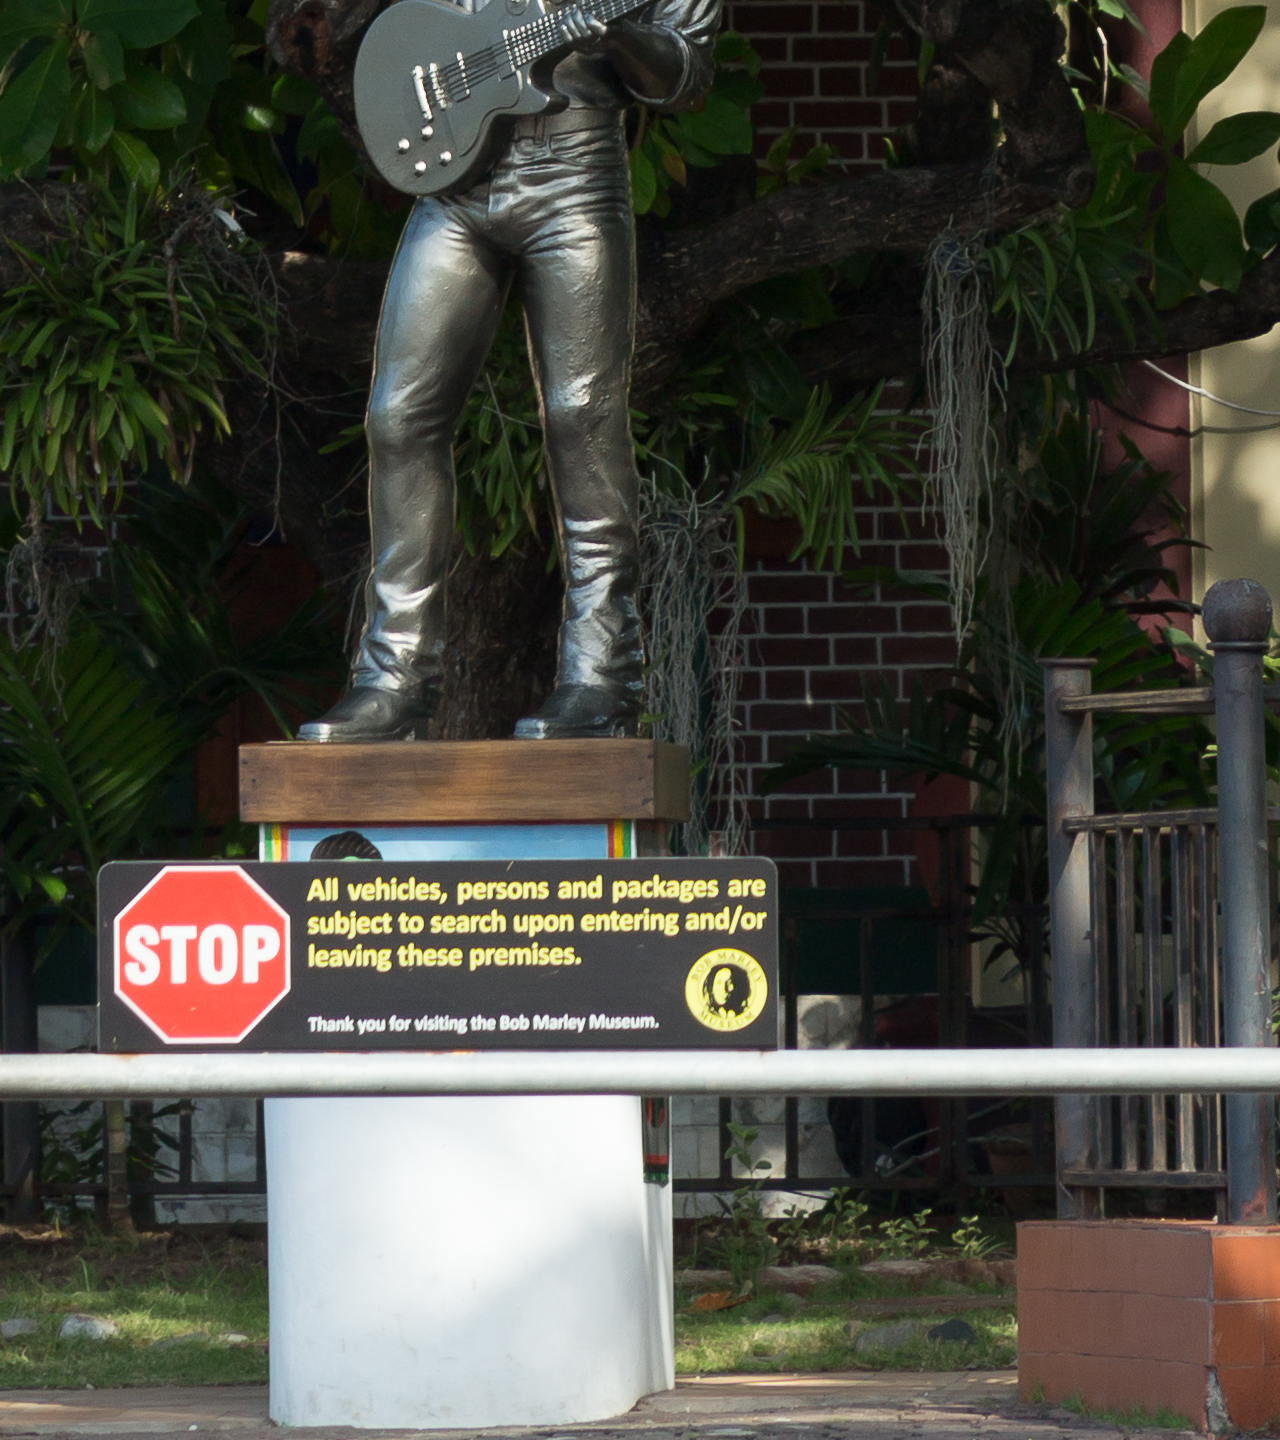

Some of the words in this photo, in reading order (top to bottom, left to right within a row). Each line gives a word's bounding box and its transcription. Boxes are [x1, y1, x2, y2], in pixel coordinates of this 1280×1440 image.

[306, 877, 339, 902] All
[347, 876, 448, 905] vehicles,
[457, 881, 550, 905] persons
[557, 874, 603, 899] and
[612, 874, 719, 904] packages
[727, 878, 766, 898] are
[307, 910, 393, 939] subject
[397, 912, 424, 934] to
[430, 908, 506, 933] search
[513, 913, 574, 937] upon
[580, 908, 680, 936] entering
[685, 905, 767, 934] and/or
[124, 923, 281, 986] STOP
[308, 943, 392, 972] leaving
[396, 942, 463, 967] these
[470, 942, 582, 972] premises.
[691, 957, 712, 981] BOB
[307, 1015, 355, 1032] Thank
[357, 1017, 386, 1035] you
[388, 1015, 412, 1032] for
[414, 1014, 468, 1035] visiting
[470, 1013, 496, 1031] the
[499, 1013, 530, 1031] Bob
[532, 1013, 586, 1034] Marley
[588, 1013, 660, 1031] Museum.
